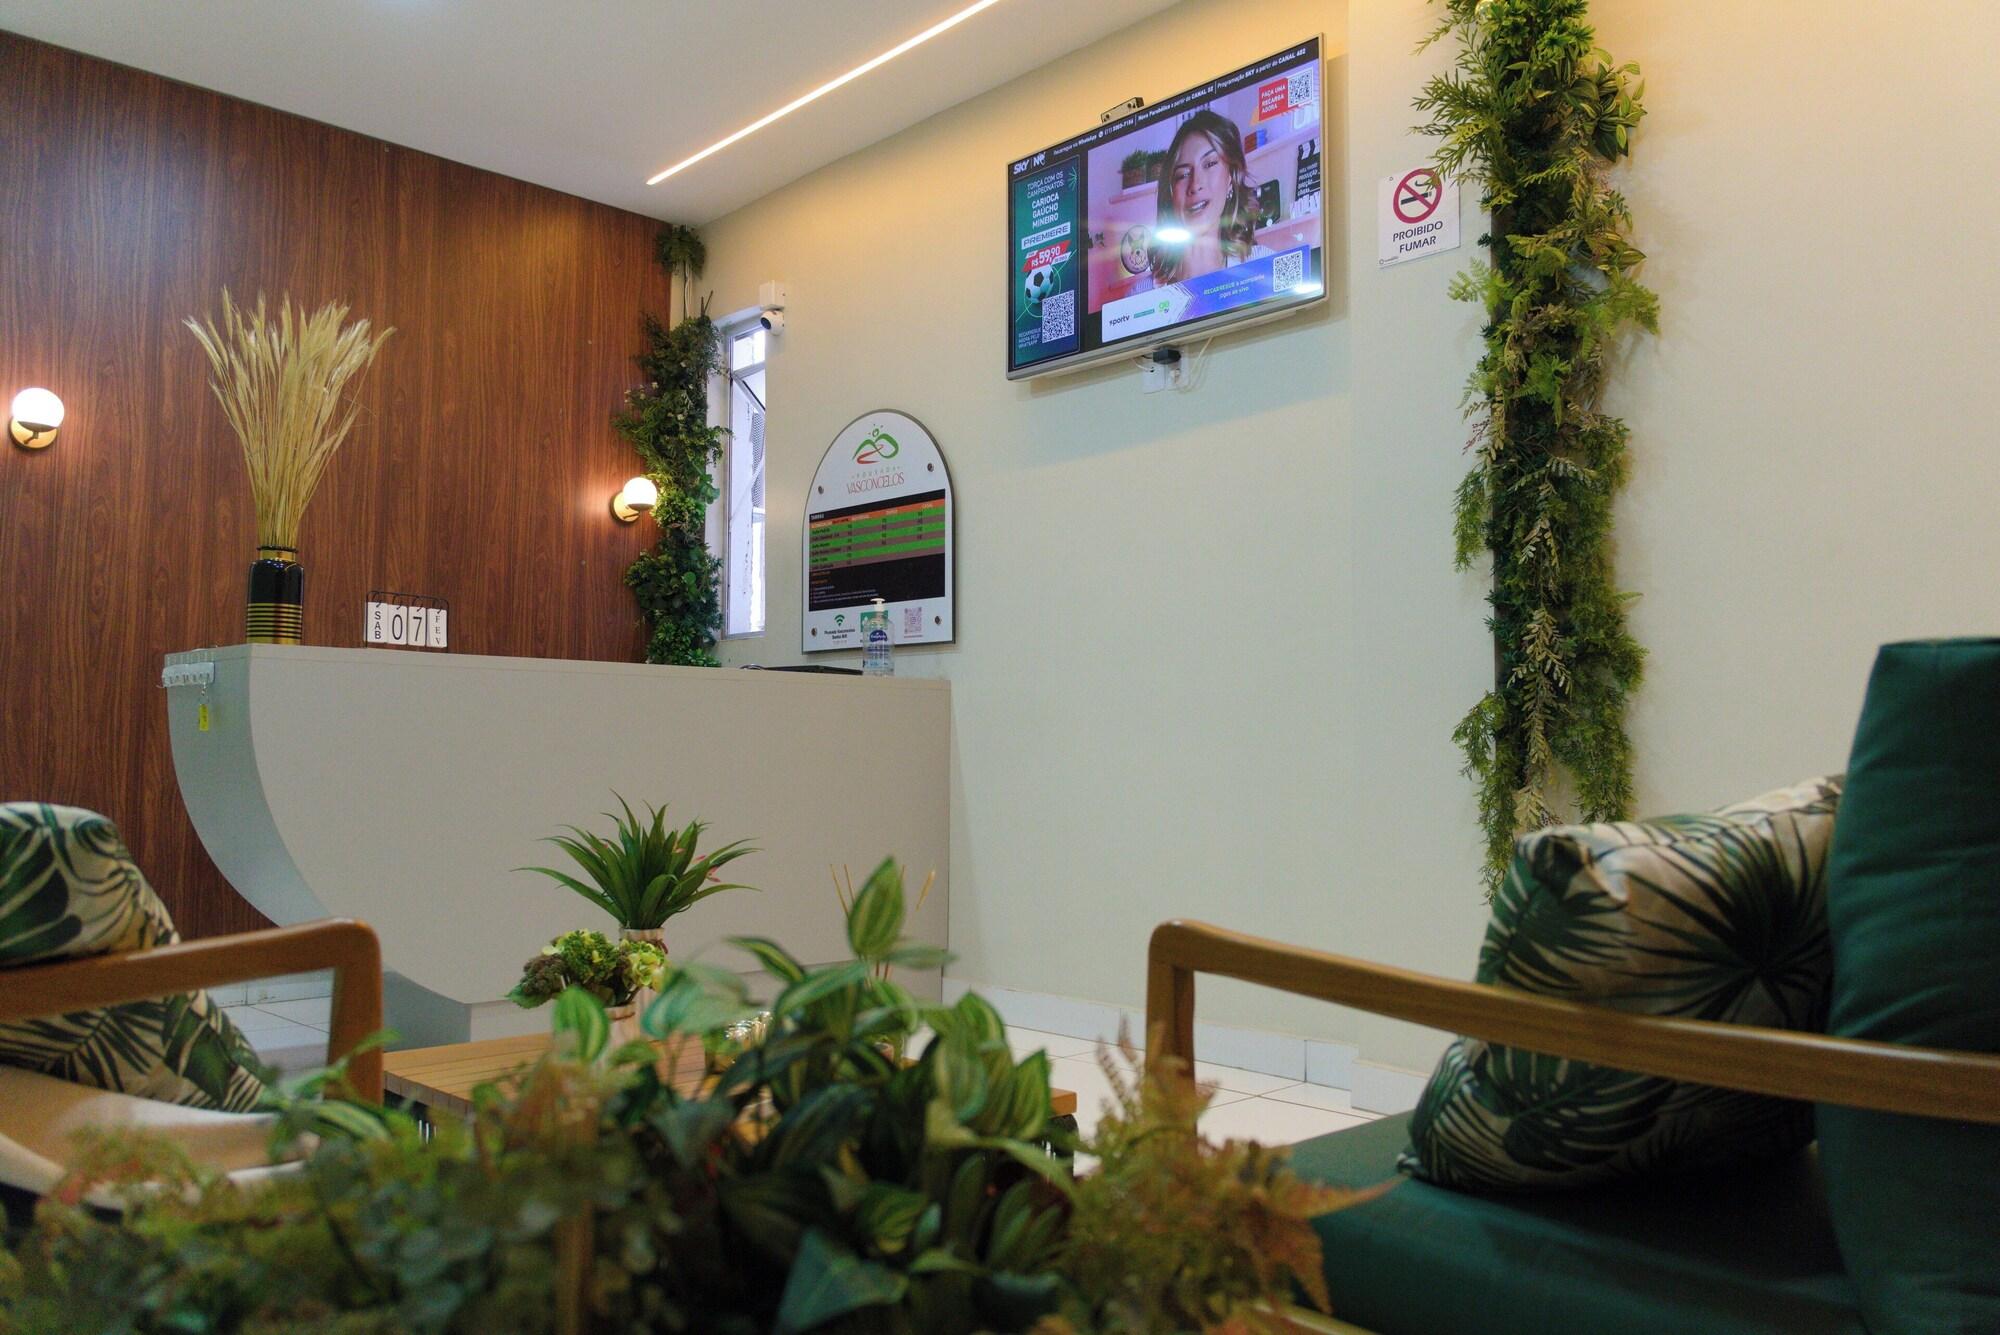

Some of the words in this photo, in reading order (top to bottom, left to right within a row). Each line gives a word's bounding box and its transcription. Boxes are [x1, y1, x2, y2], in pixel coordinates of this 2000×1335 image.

[1217, 73, 1245, 88] Programação
[1245, 68, 1255, 78] SKY
[1278, 52, 1296, 64] CANAL
[1191, 89, 1207, 100] CANAL
[1261, 90, 1274, 99] FAÇA
[1274, 84, 1286, 93] UMA
[1261, 103, 1277, 113] AGORA
[1013, 159, 1030, 175] SKY
[1044, 174, 1056, 185] COM
[1055, 170, 1064, 179] OS
[1031, 192, 1060, 209] CARIOCA
[1032, 202, 1059, 219] GAÚCHO
[1032, 212, 1059, 229] MINEIRO
[1023, 225, 1069, 248] PREMIERE
[1392, 220, 1443, 242] PROIBIDO
[1399, 235, 1437, 253] FUMAR
[1038, 246, 1061, 265] 59,90
[1109, 314, 1130, 327] sportv
[846, 471, 905, 494] VASCONCELOS
[374, 610, 382, 640] SAB
[391, 613, 423, 642] 07
